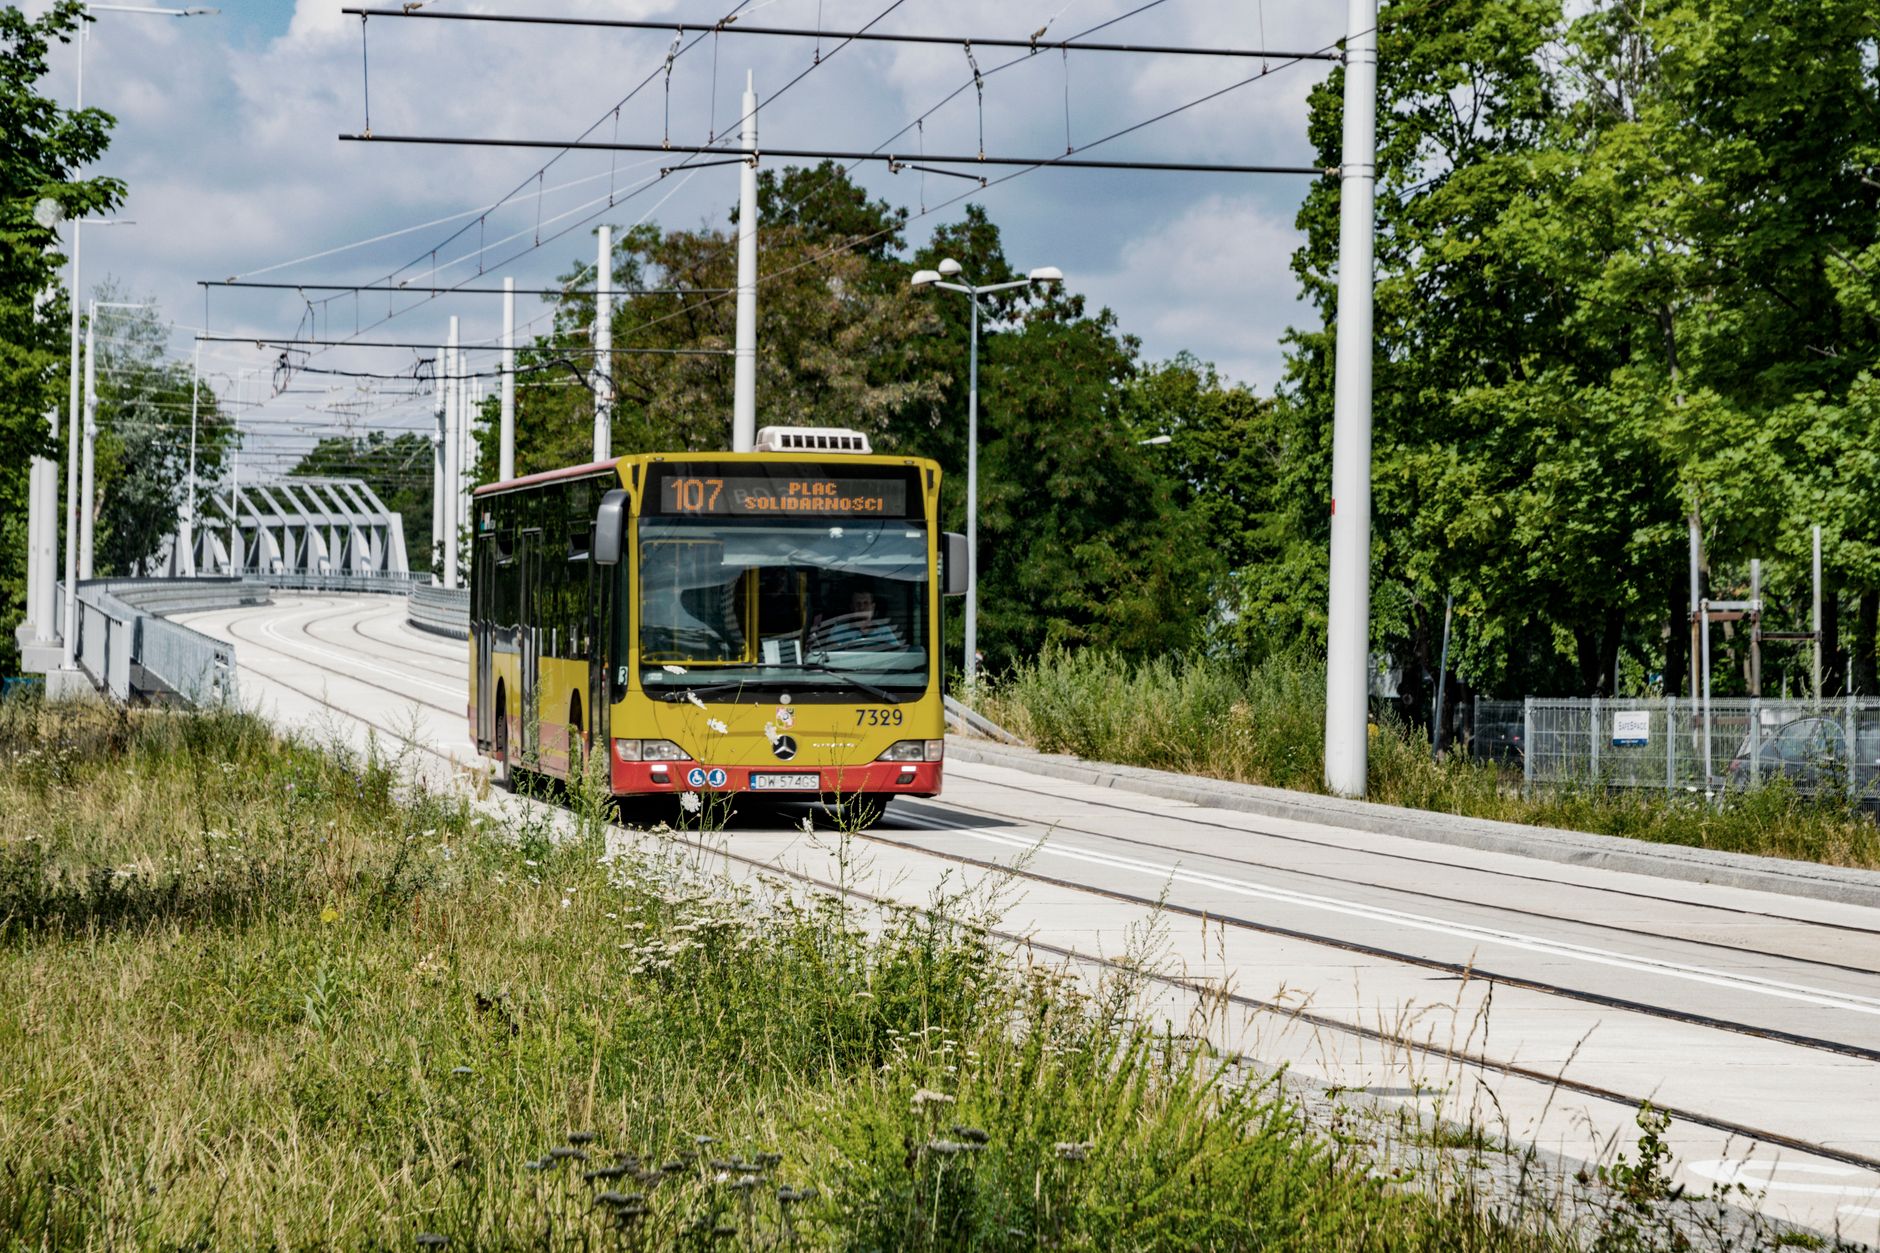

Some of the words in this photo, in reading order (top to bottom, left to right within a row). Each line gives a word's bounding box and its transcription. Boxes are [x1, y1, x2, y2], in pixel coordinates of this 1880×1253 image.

[671, 479, 724, 512] 107
[788, 481, 838, 496] PLAC
[744, 496, 883, 511] SOLIDARNOŚCI
[856, 708, 903, 727] 7329
[758, 775, 775, 788] DW
